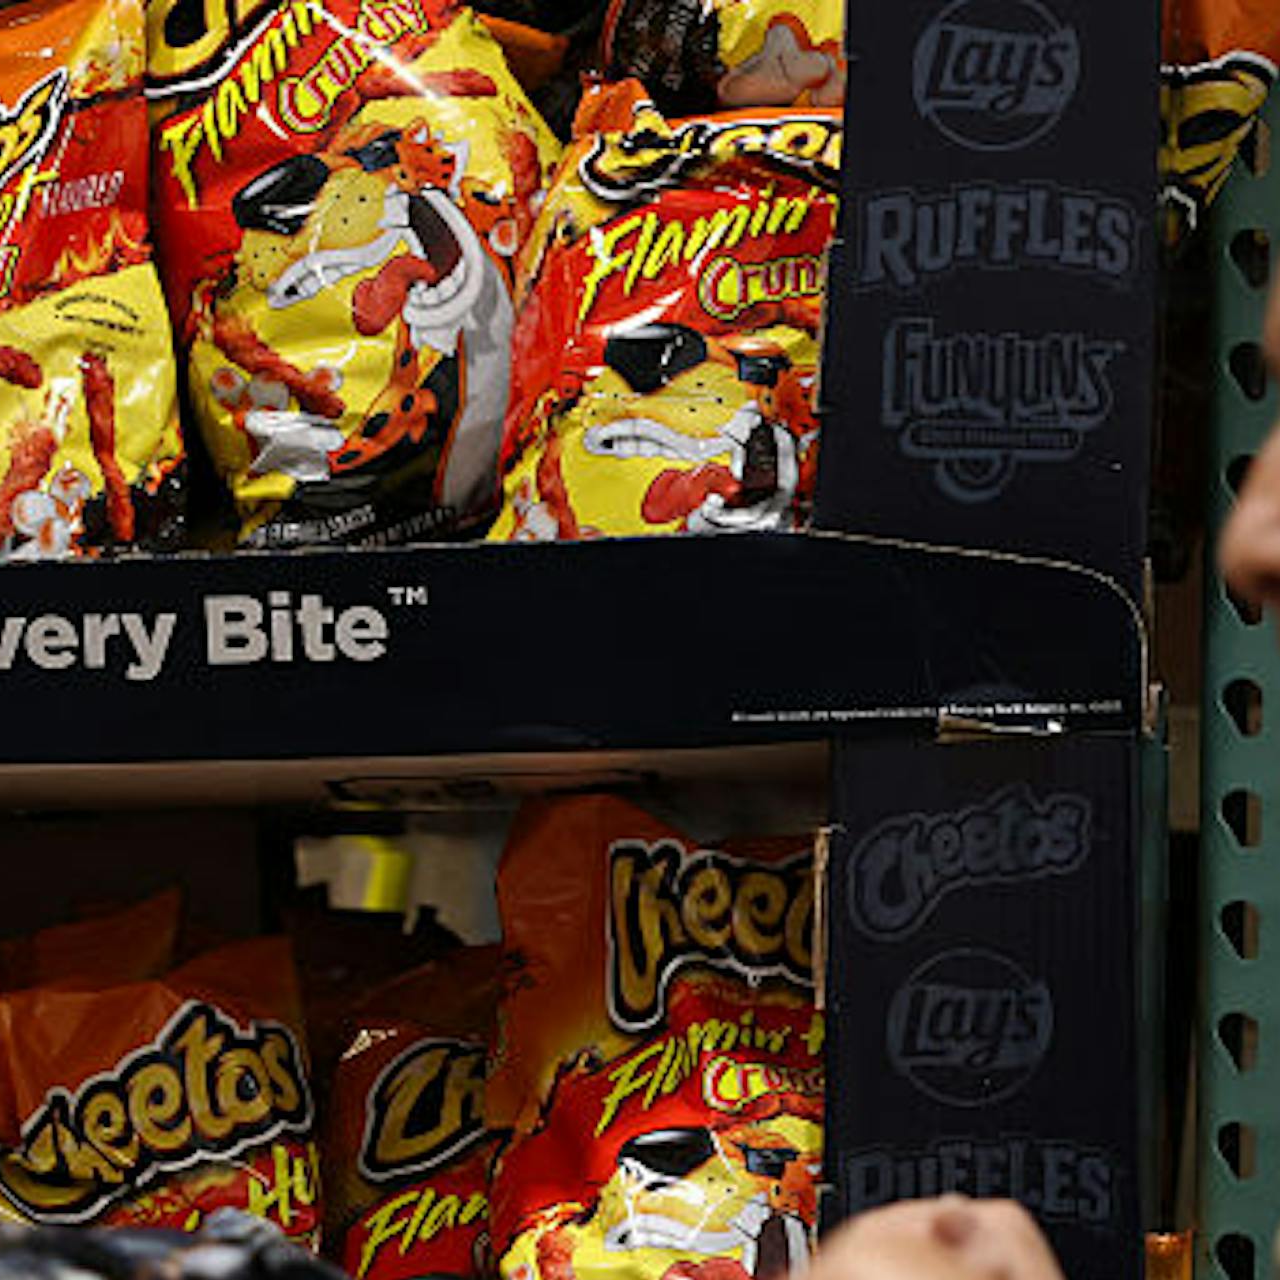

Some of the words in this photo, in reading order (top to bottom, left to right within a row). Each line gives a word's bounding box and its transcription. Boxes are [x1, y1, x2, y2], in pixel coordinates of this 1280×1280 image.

[699, 254, 822, 321] Crun
[858, 182, 1136, 288] RUFFLES
[851, 788, 1090, 938] Cheetos
